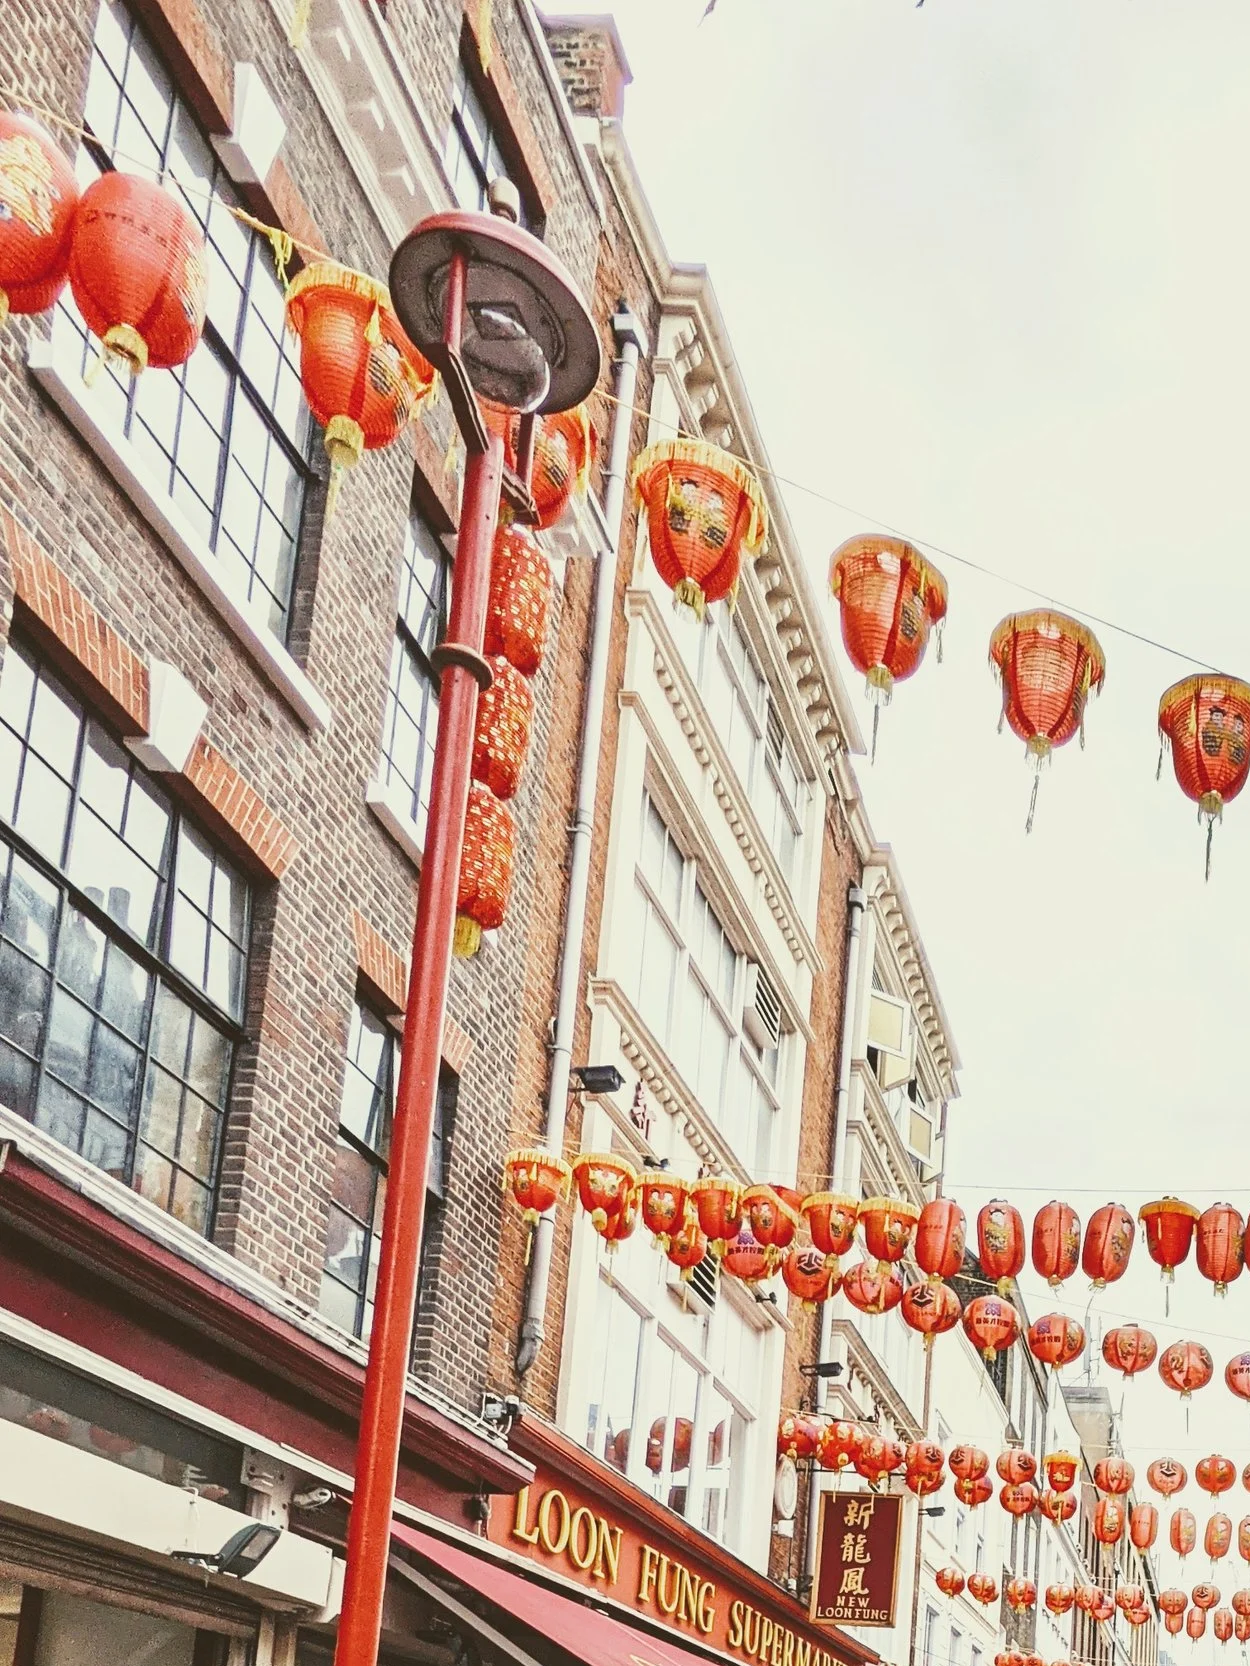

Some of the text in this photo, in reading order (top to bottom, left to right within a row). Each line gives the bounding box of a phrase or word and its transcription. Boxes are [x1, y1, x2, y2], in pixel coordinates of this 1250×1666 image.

[513, 1485, 625, 1586] LOON
[638, 1543, 717, 1633] FUNG
[840, 1499, 875, 1596] 新龍鳳
[836, 1595, 871, 1608] NEW
